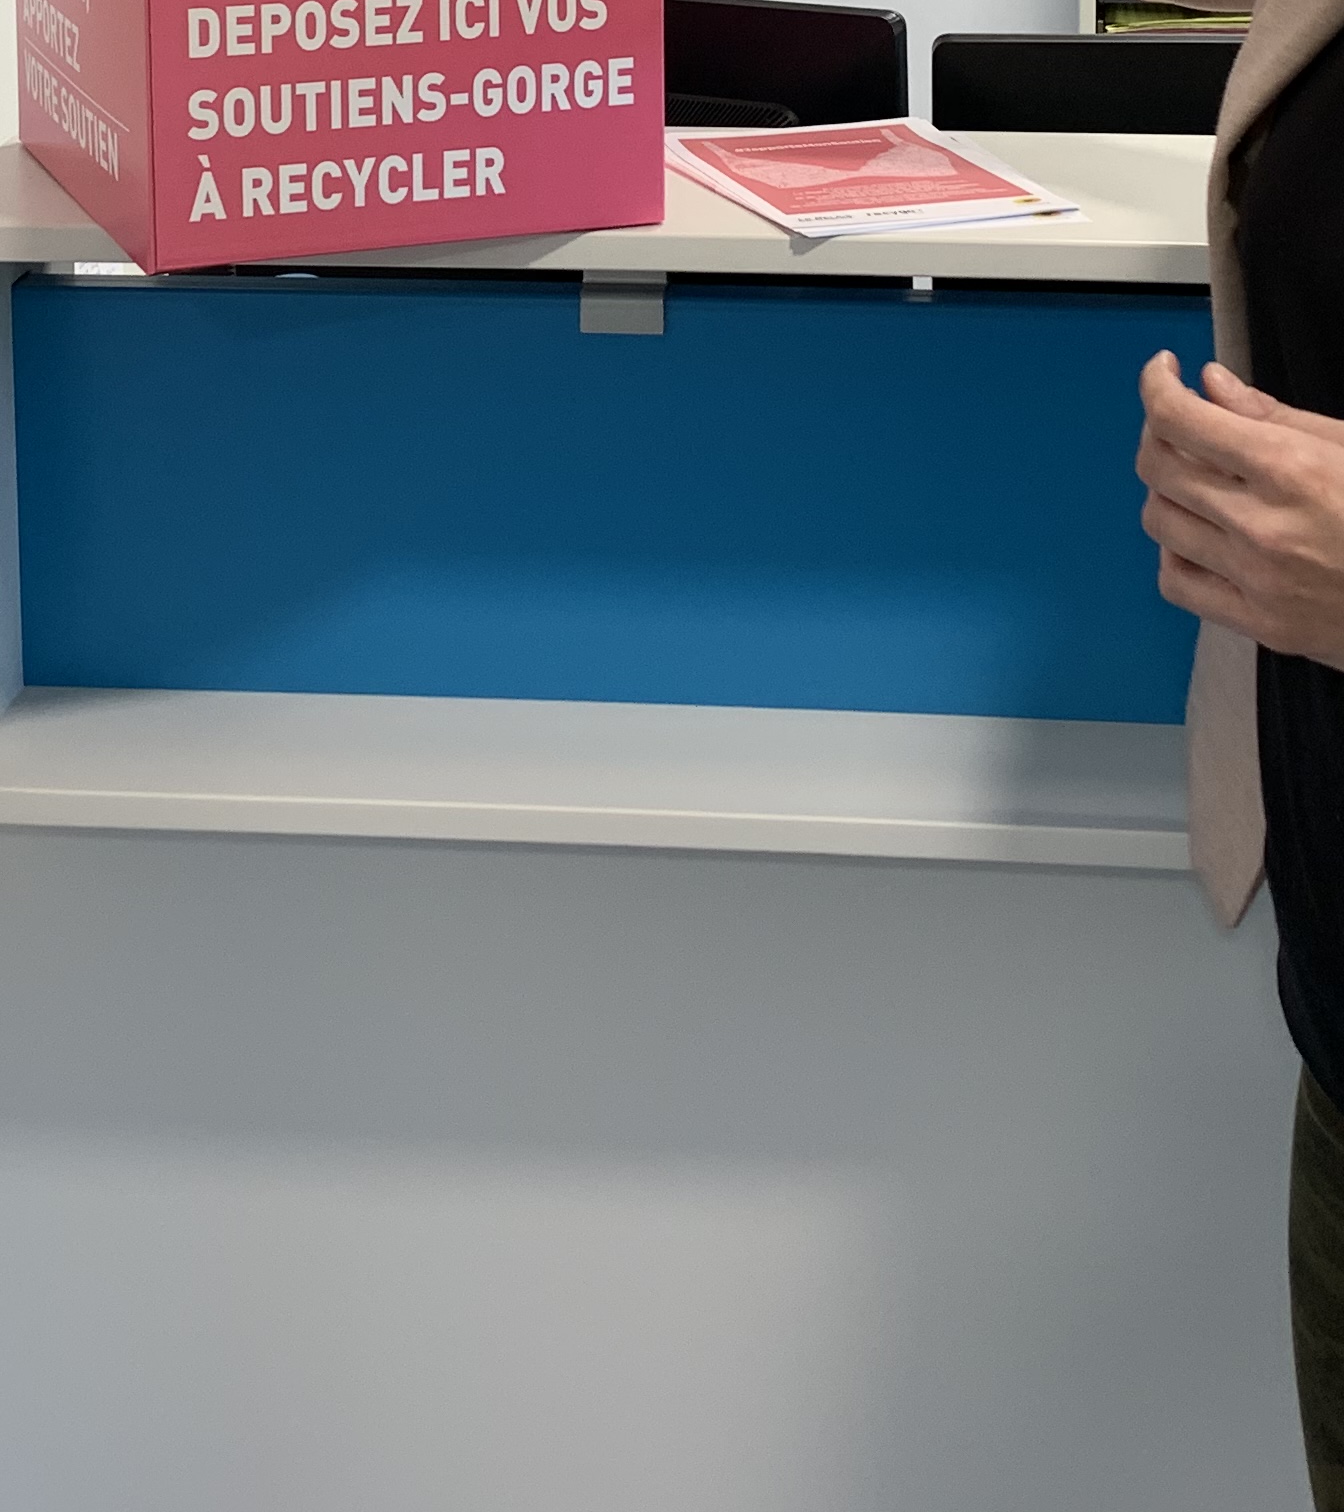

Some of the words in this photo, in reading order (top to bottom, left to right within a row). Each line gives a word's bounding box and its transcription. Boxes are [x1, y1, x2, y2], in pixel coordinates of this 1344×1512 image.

[24, 48, 60, 125] VOTRE
[60, 85, 120, 182] SOUTIEN
[186, 56, 636, 141] SOUTIENS-GORGE
[189, 153, 227, 223] À
[241, 147, 507, 218] RECYCLER
